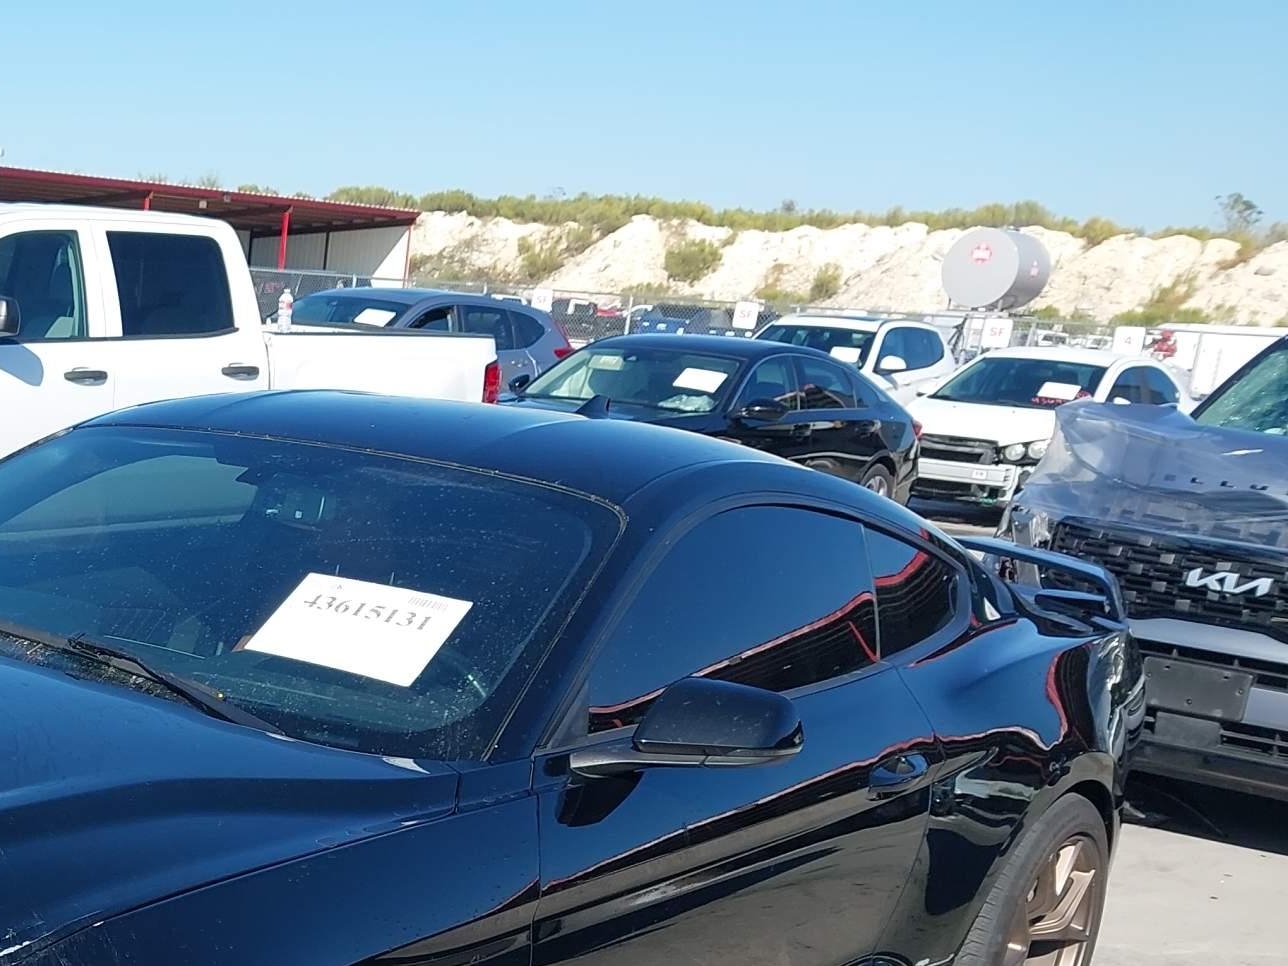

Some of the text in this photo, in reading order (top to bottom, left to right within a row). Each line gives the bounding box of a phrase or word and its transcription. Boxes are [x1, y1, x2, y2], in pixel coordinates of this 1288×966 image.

[989, 327, 1006, 337] SF
[1185, 567, 1274, 597] KIA
[303, 593, 432, 631] 43615131
